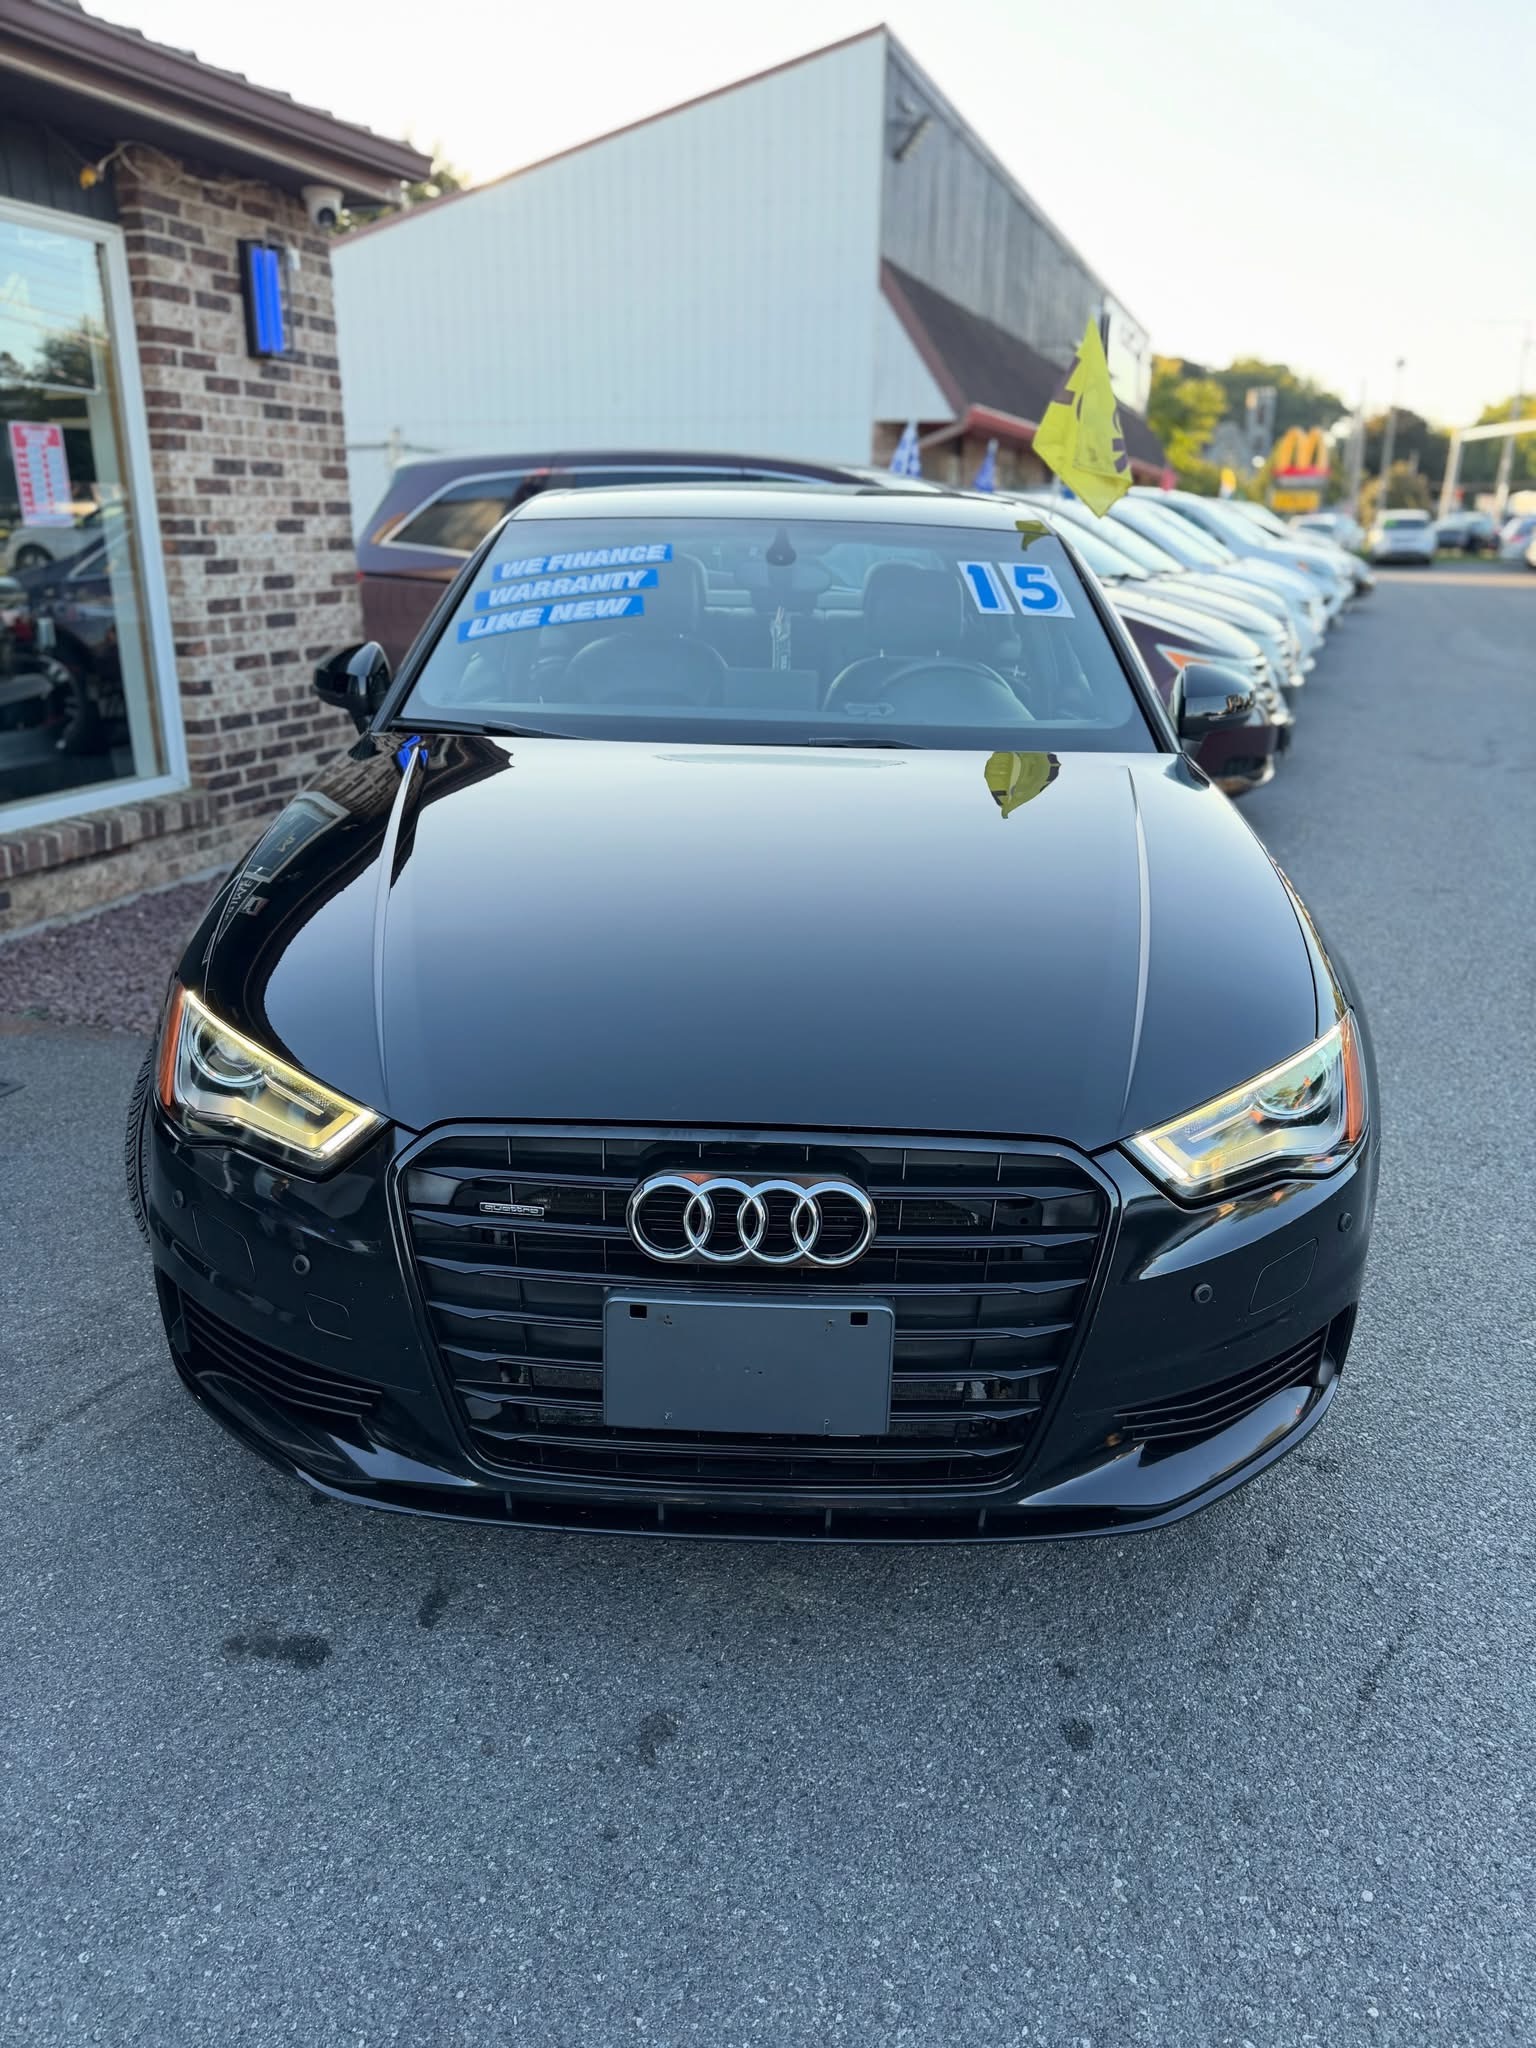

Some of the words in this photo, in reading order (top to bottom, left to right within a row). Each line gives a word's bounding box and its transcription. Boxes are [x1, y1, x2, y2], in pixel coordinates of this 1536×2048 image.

[501, 557, 546, 578] WE
[547, 545, 668, 571] FINANCE
[488, 571, 648, 606] WARRANTY
[467, 607, 544, 637] LIKE
[549, 598, 631, 621] NEW
[484, 1204, 539, 1214] quattro
